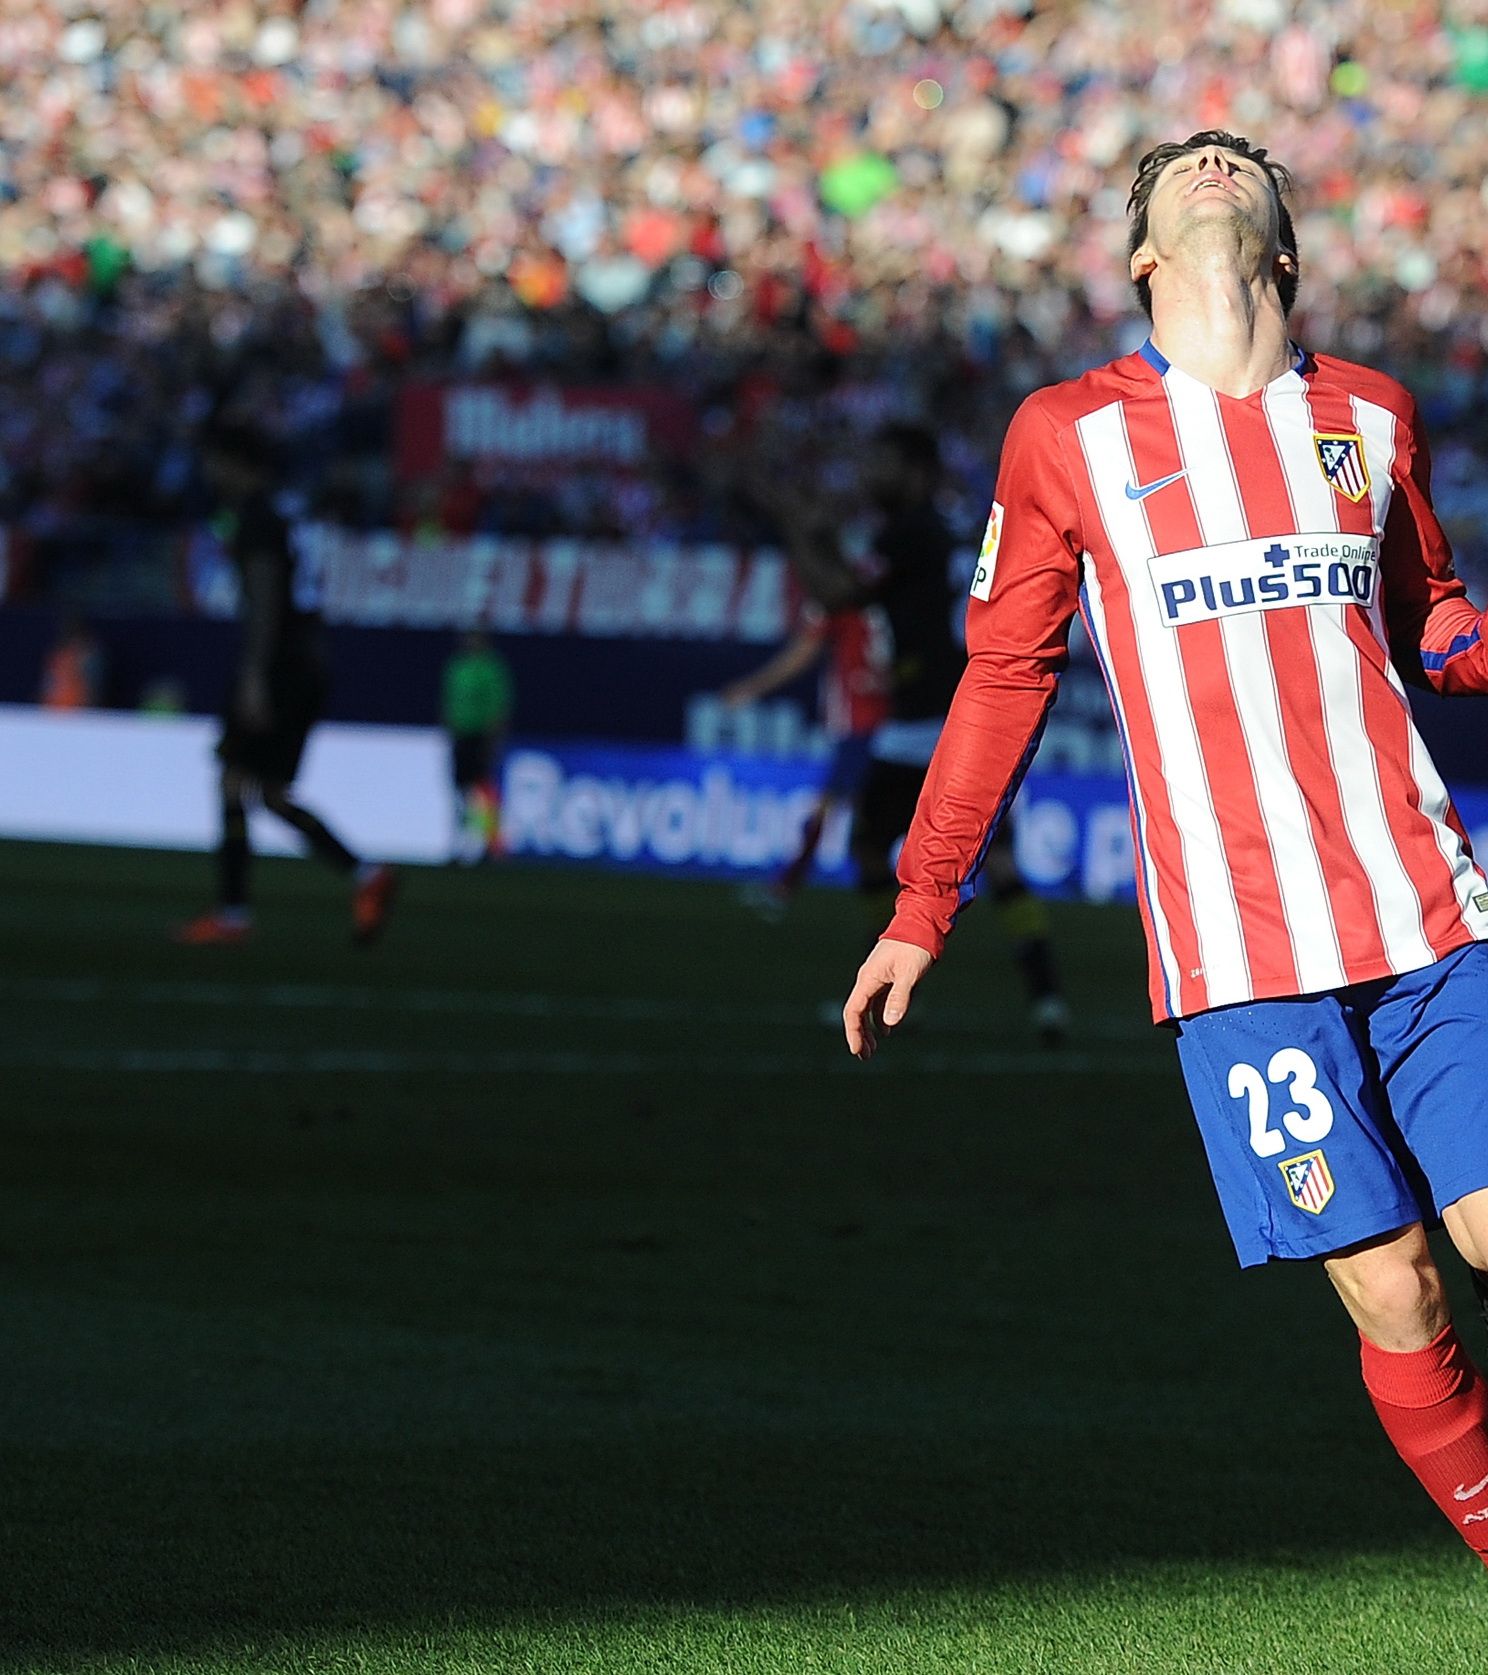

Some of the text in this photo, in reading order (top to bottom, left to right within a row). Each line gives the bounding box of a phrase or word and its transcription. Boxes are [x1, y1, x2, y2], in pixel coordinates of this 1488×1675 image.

[1294, 543, 1376, 562] Trade Online
[1161, 562, 1372, 619] Plus500
[1227, 1047, 1335, 1159] 23
